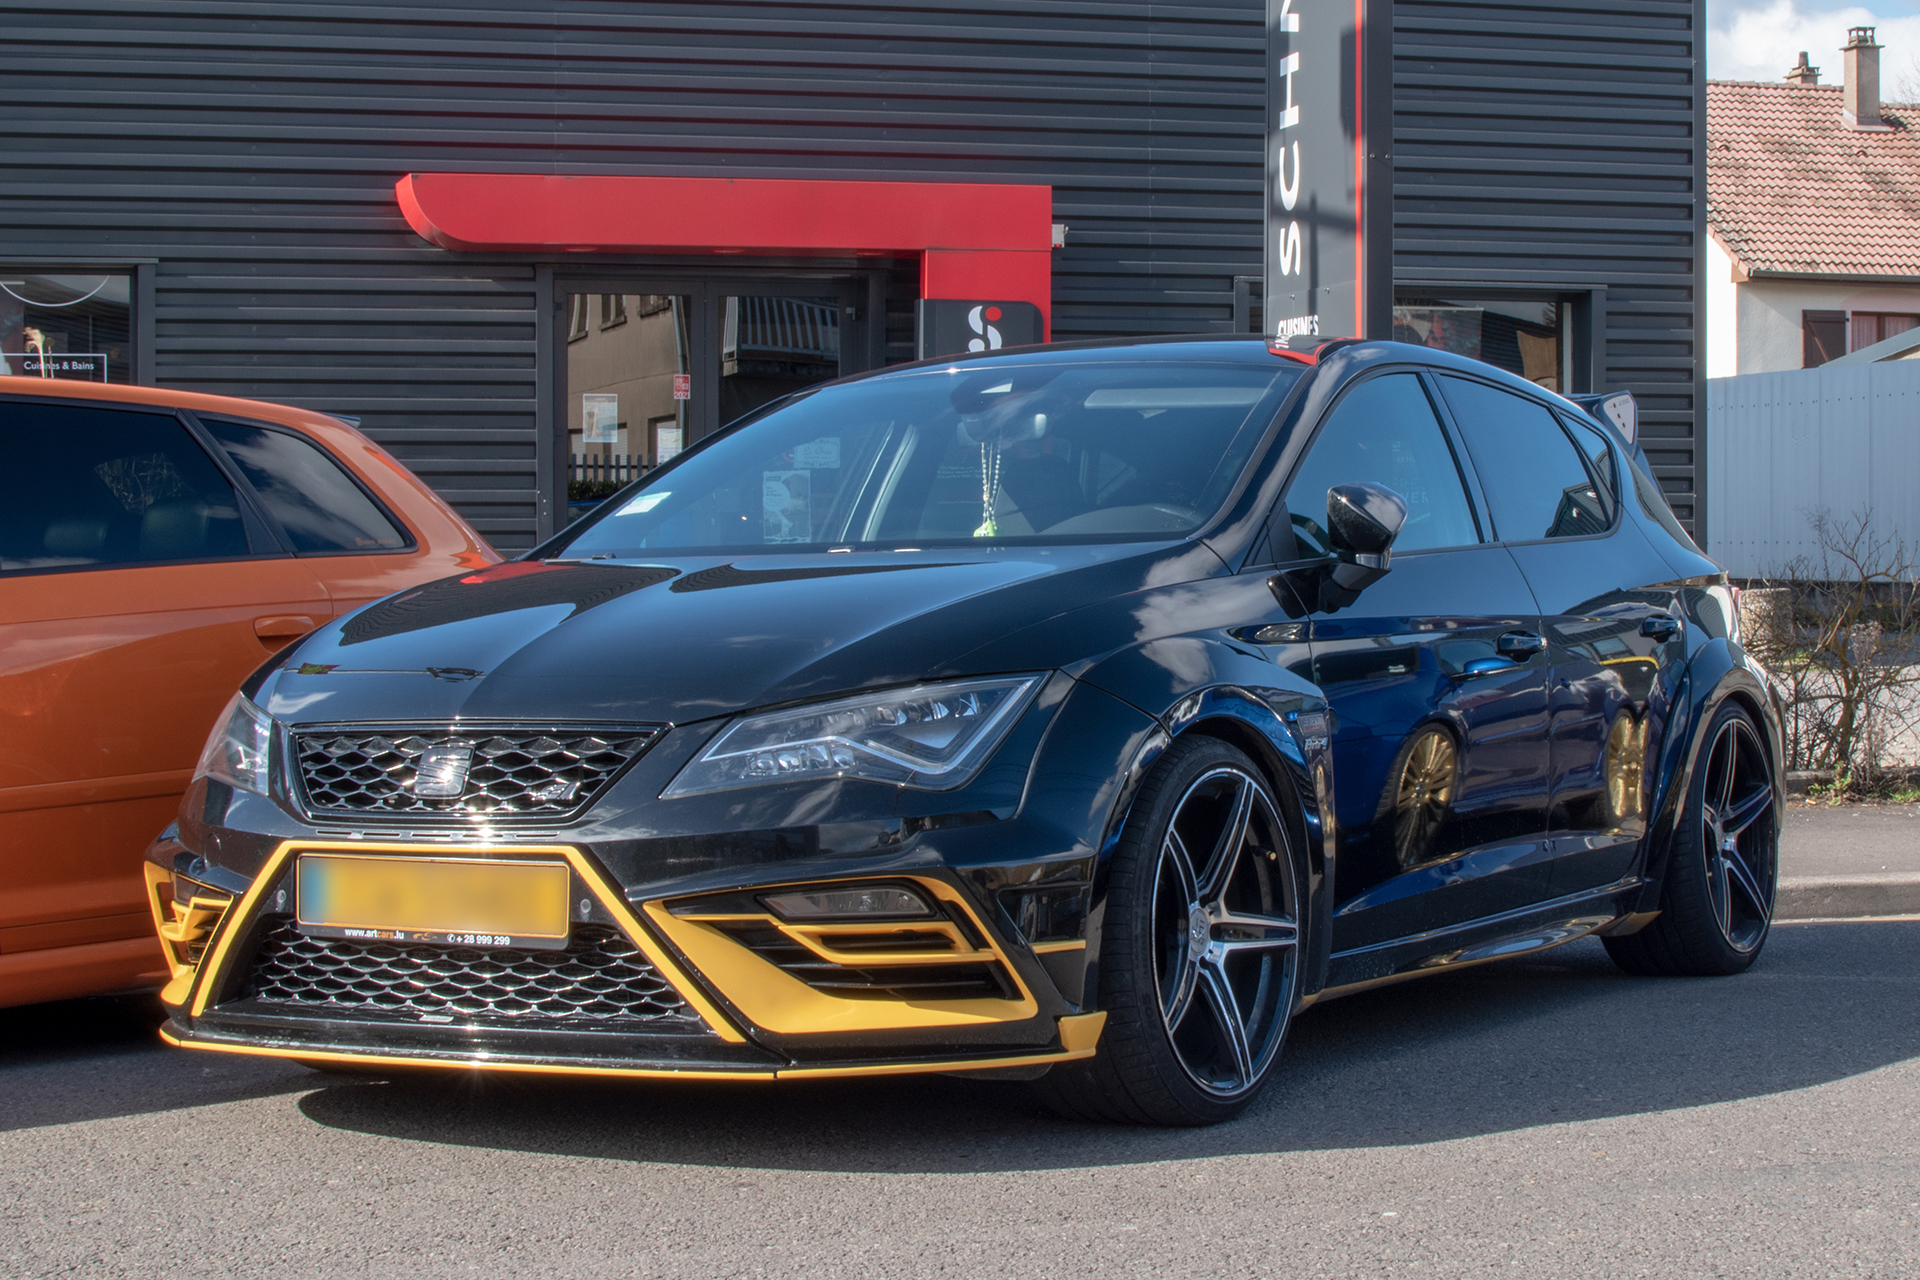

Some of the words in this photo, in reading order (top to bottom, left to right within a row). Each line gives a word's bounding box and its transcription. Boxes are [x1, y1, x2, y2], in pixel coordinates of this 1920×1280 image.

[62, 361, 70, 370] &
[71, 361, 94, 370] Bains
[344, 928, 405, 940] www.artcars.lu
[463, 934, 475, 944] 28
[476, 934, 492, 945] 999
[493, 935, 511, 946] 299
